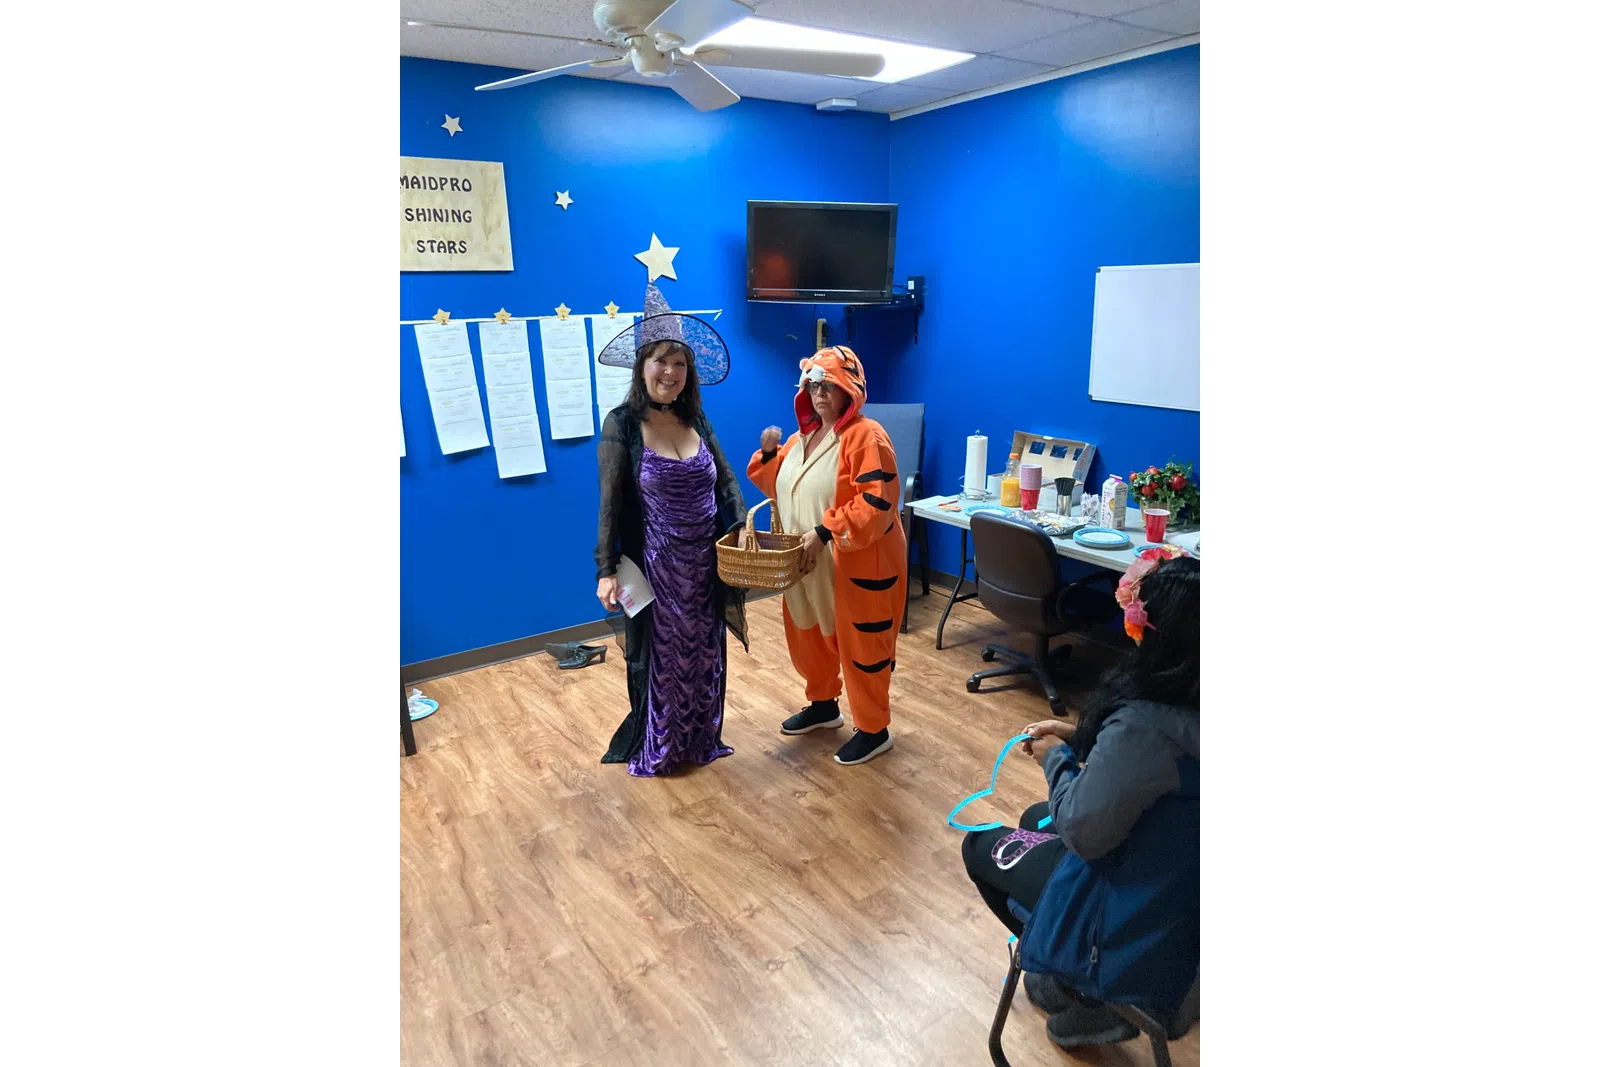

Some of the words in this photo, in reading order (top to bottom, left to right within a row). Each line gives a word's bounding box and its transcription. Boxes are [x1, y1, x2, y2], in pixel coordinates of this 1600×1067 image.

[400, 175, 472, 192] MAIDPRO
[405, 208, 472, 223] SHINING
[417, 239, 467, 254] STARS
